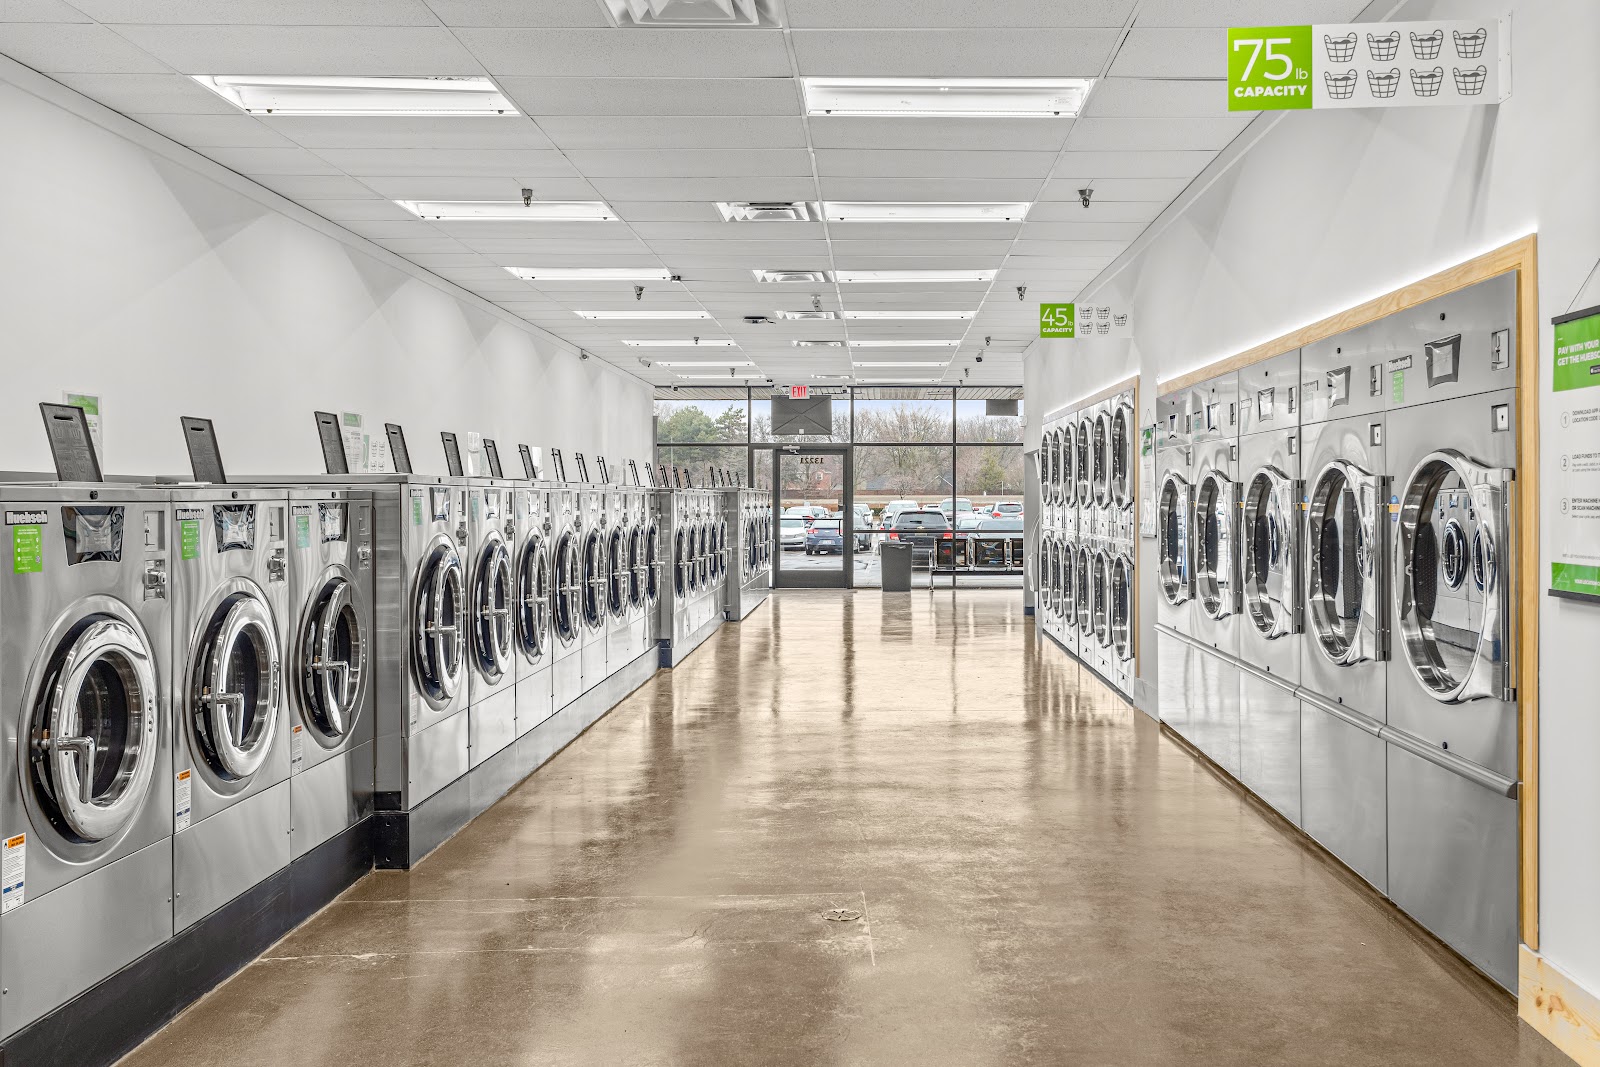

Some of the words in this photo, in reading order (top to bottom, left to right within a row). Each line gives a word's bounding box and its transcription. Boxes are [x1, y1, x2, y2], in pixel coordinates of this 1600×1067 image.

[1233, 38, 1293, 82] 75
[1295, 67, 1309, 80] lb
[1233, 85, 1308, 98] CAPACITY
[1041, 307, 1068, 326] 45
[1558, 346, 1568, 355] PAY
[1569, 343, 1583, 352] WITH
[1558, 356, 1568, 366] GET
[1569, 354, 1580, 364] THE
[792, 385, 807, 398] EXIT
[6, 511, 47, 524] Huebsch
